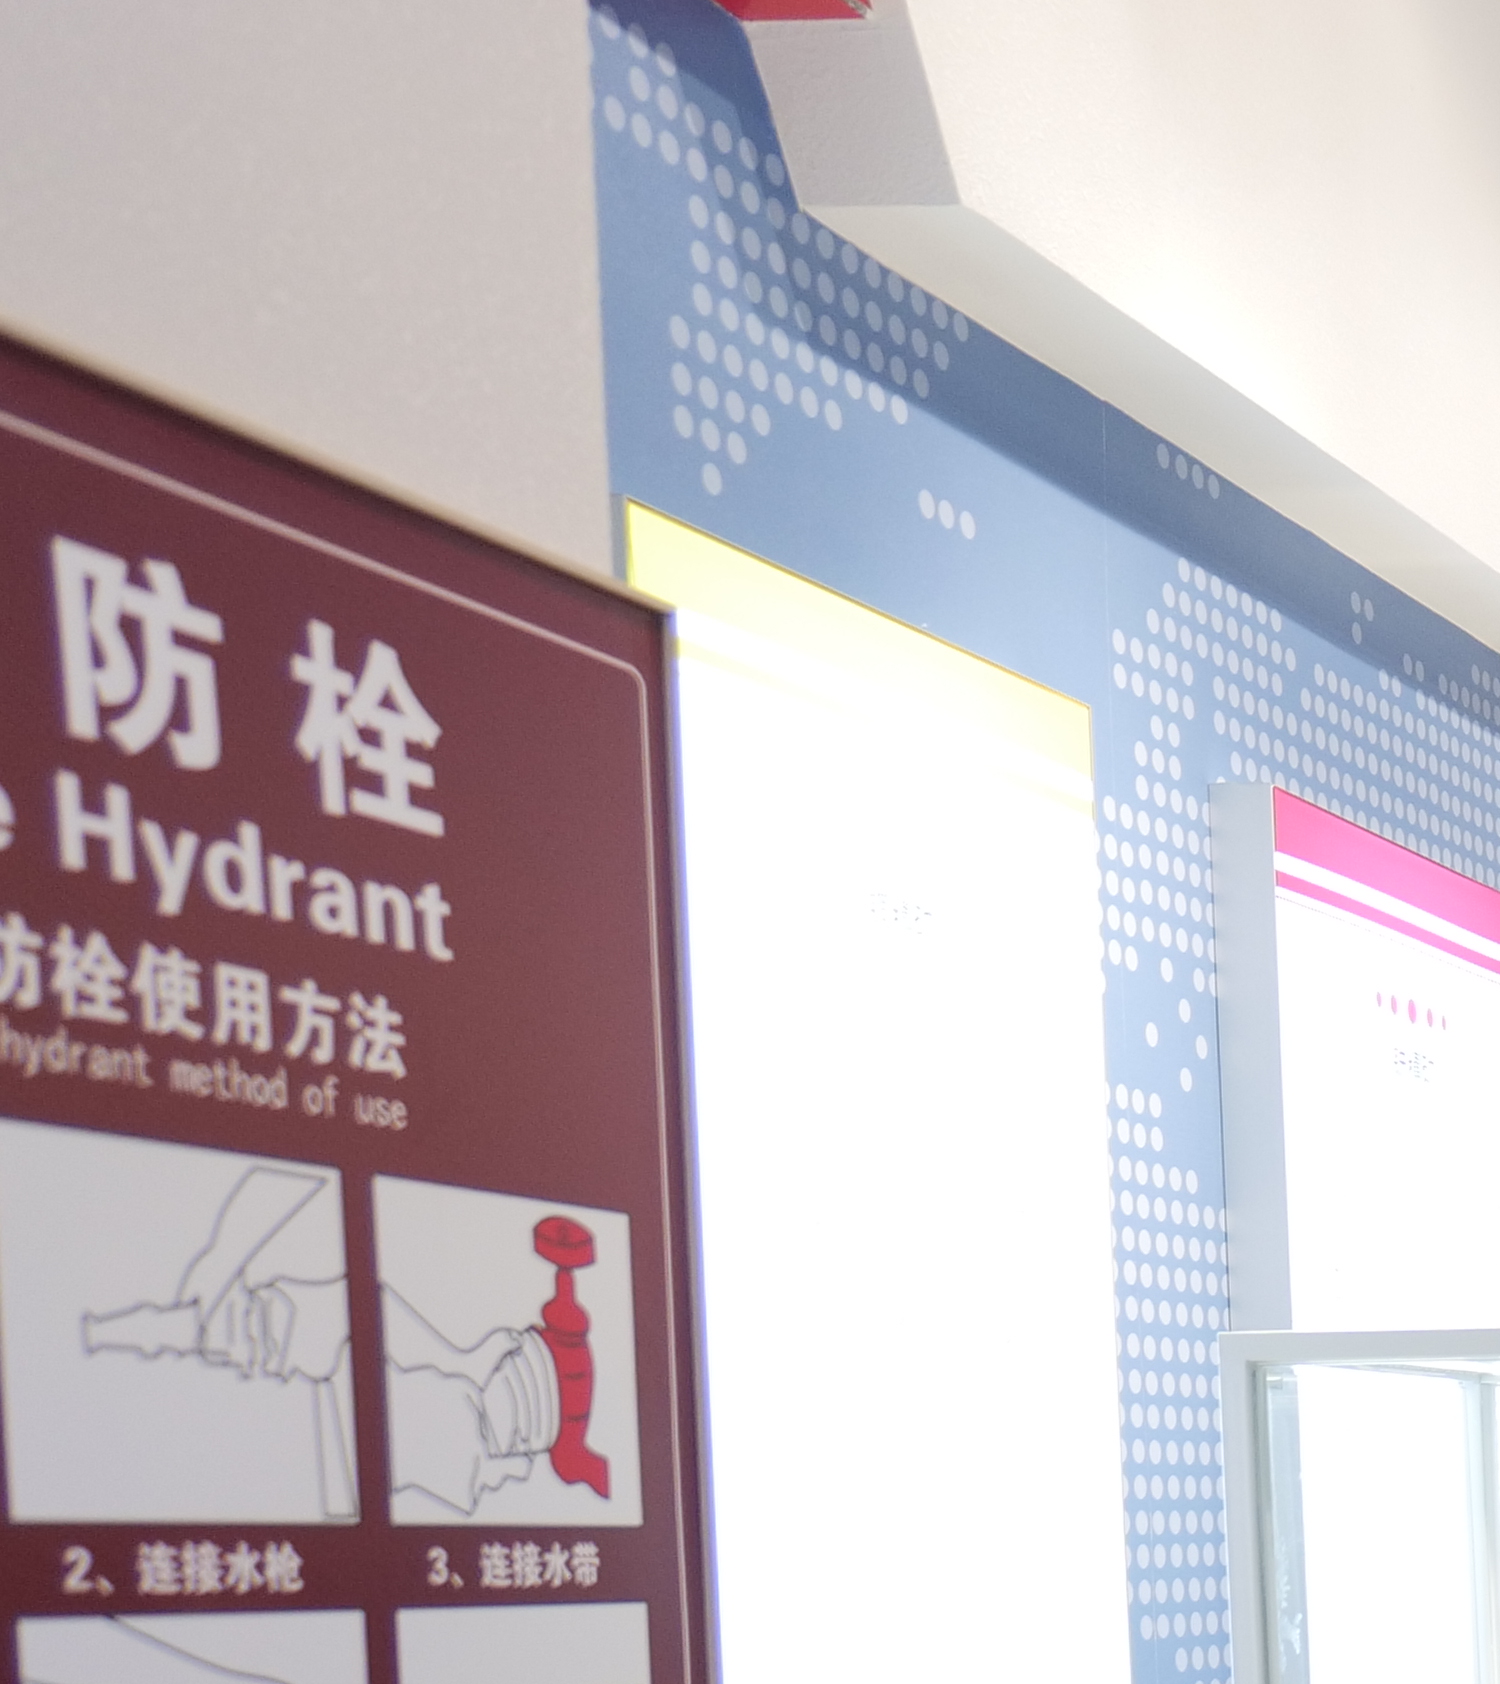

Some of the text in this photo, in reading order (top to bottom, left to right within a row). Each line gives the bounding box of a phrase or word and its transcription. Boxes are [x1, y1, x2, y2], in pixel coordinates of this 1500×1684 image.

[51, 534, 446, 837] 防栓
[54, 769, 454, 961] Hydrant
[0, 1013, 408, 1130] hydrant method of use
